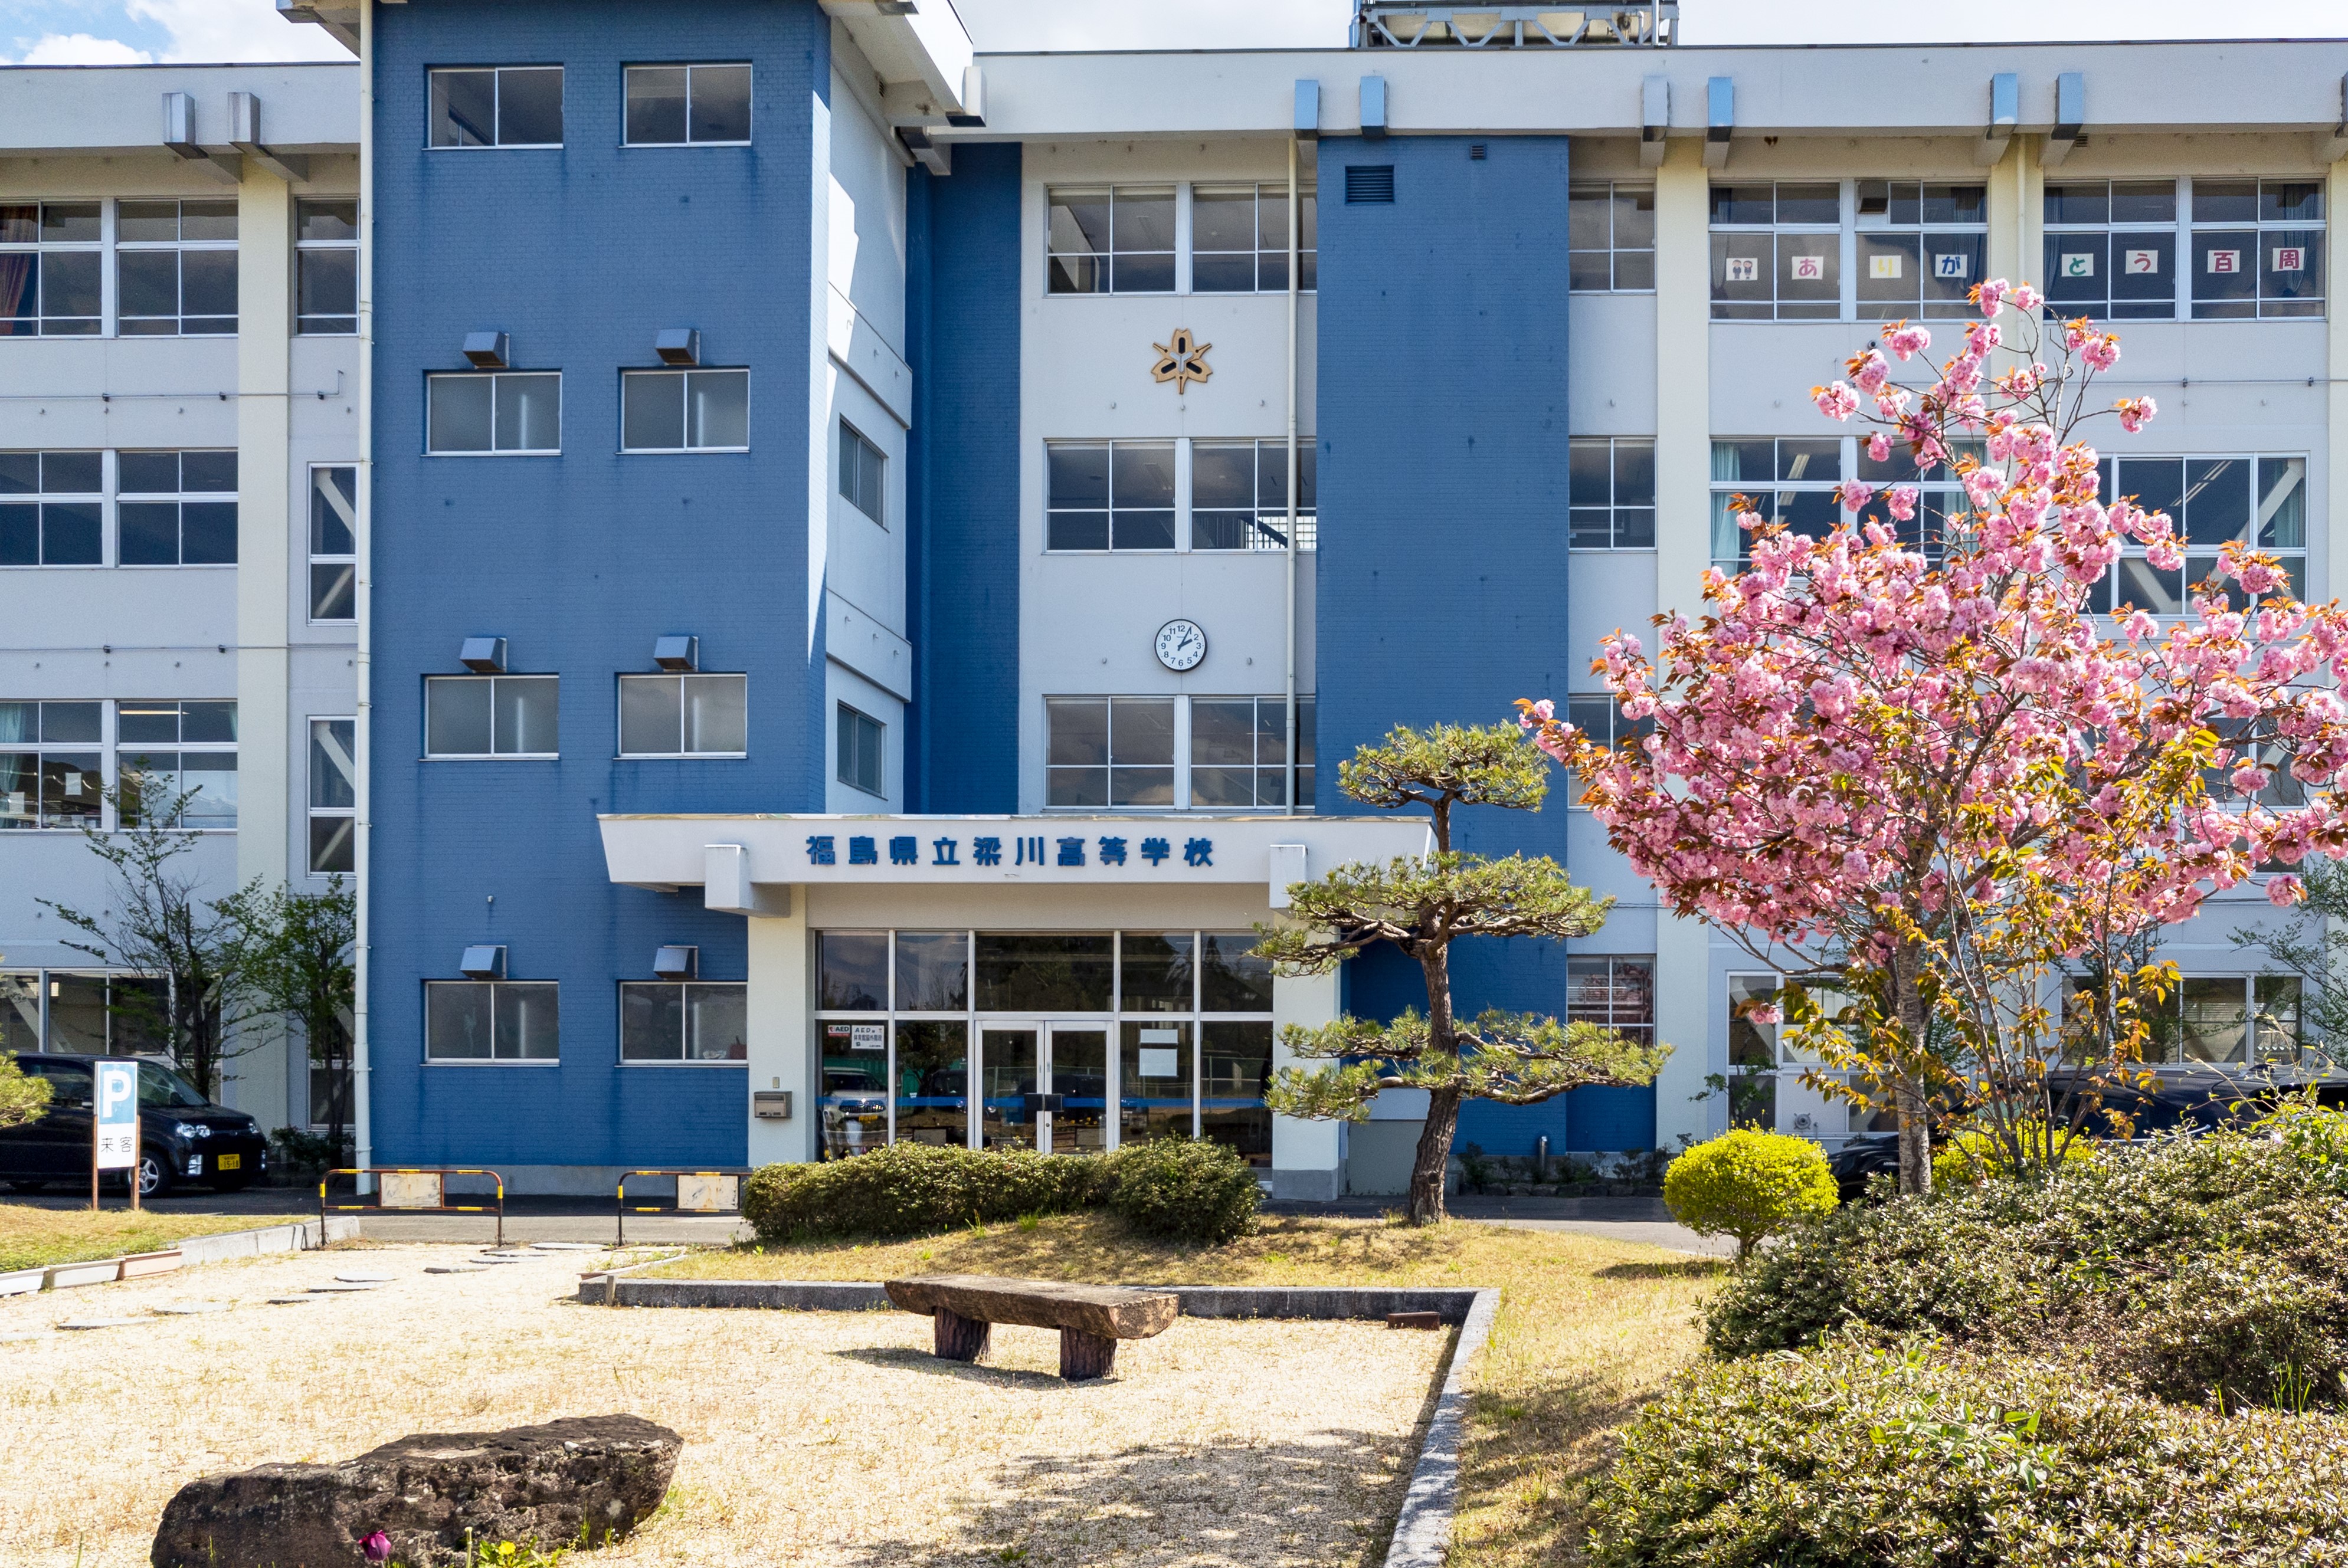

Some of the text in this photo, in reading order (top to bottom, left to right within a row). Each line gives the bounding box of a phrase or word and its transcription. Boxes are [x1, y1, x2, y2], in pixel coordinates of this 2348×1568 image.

[806, 836, 1213, 866] 福島県立梁川高等学校
[103, 1070, 132, 1118] P
[101, 1136, 132, 1153] 来客
